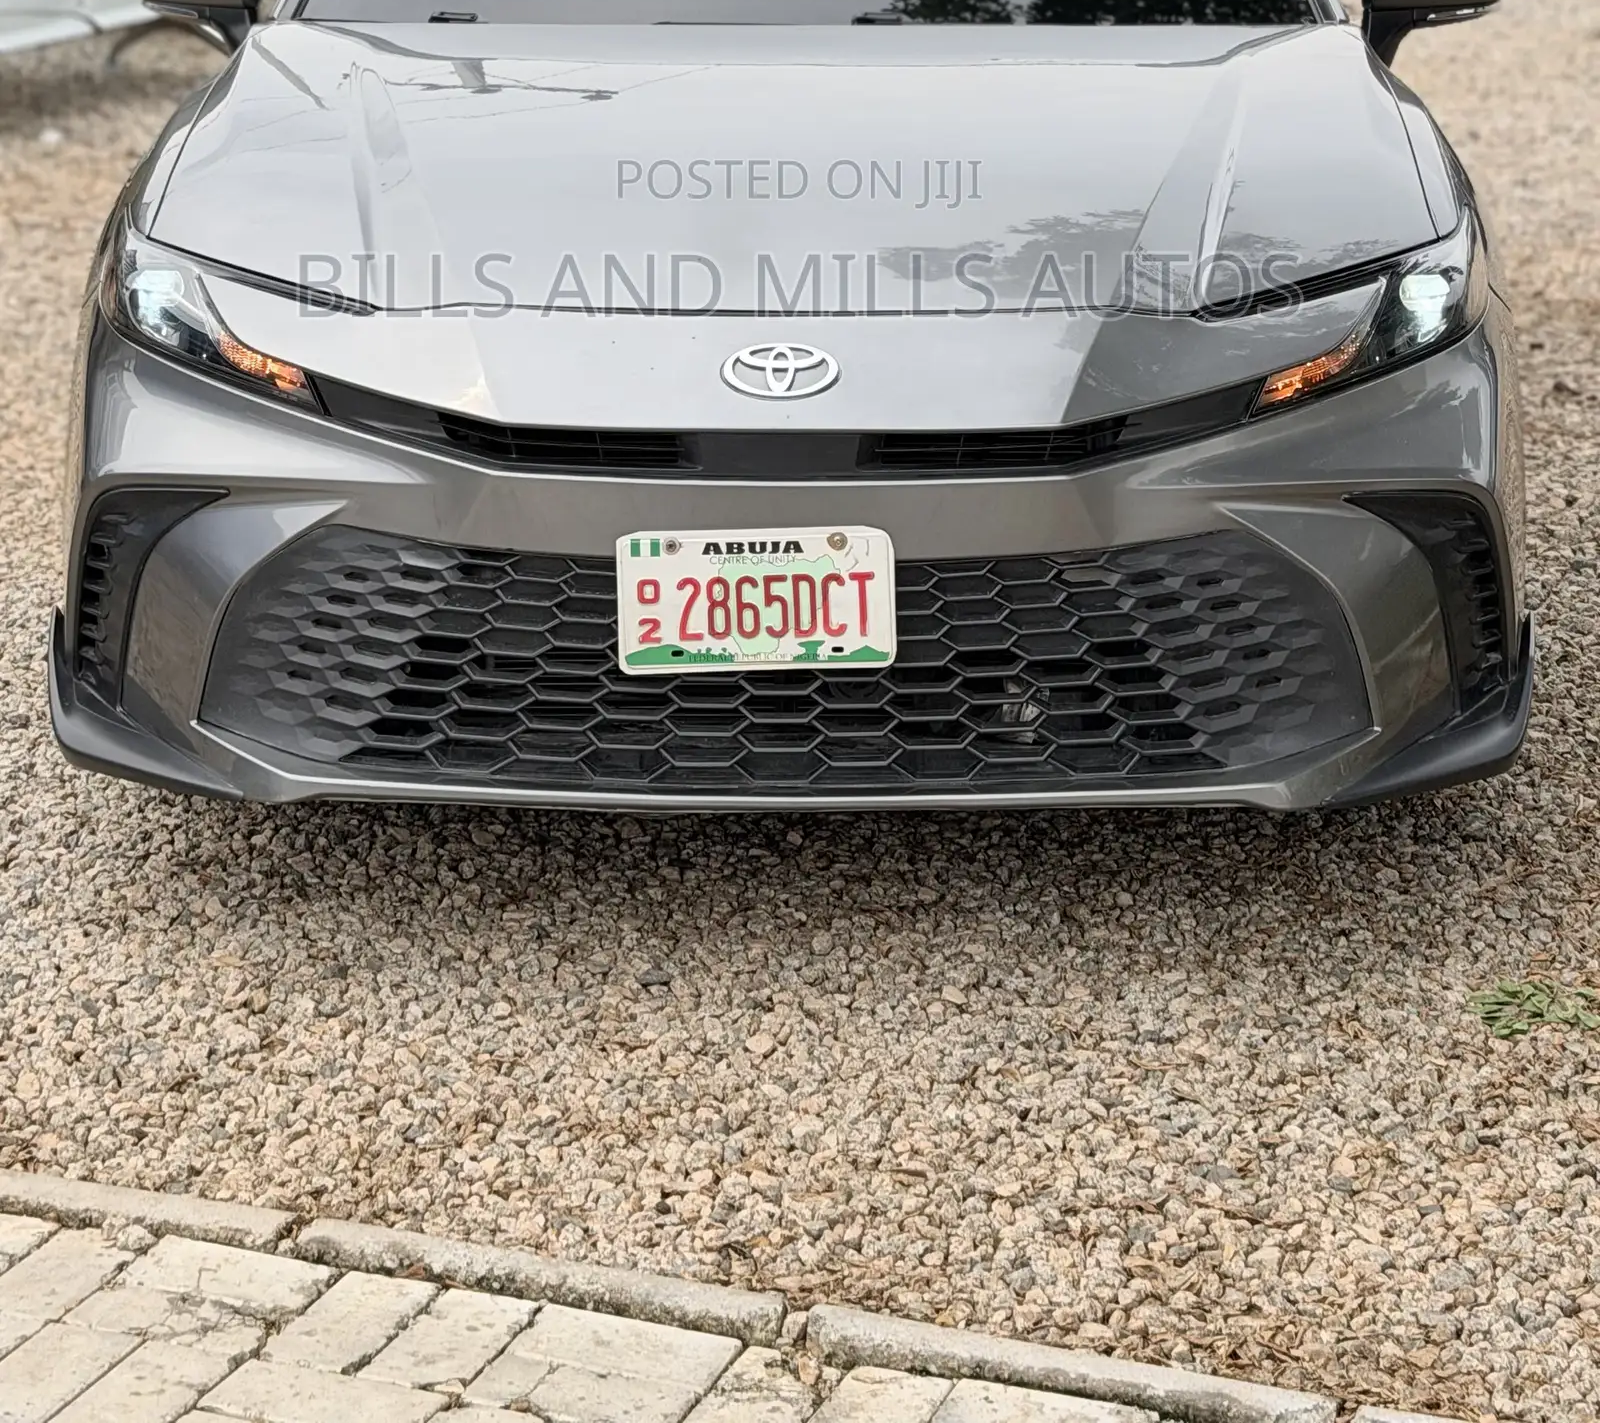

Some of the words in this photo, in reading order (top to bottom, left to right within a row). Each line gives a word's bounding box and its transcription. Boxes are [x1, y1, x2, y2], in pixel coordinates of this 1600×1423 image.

[701, 540, 805, 556] ABUJA
[709, 555, 748, 566] CENTRE
[750, 555, 765, 566] OF
[767, 554, 797, 565] UNITY
[675, 570, 876, 642] 2865DCT
